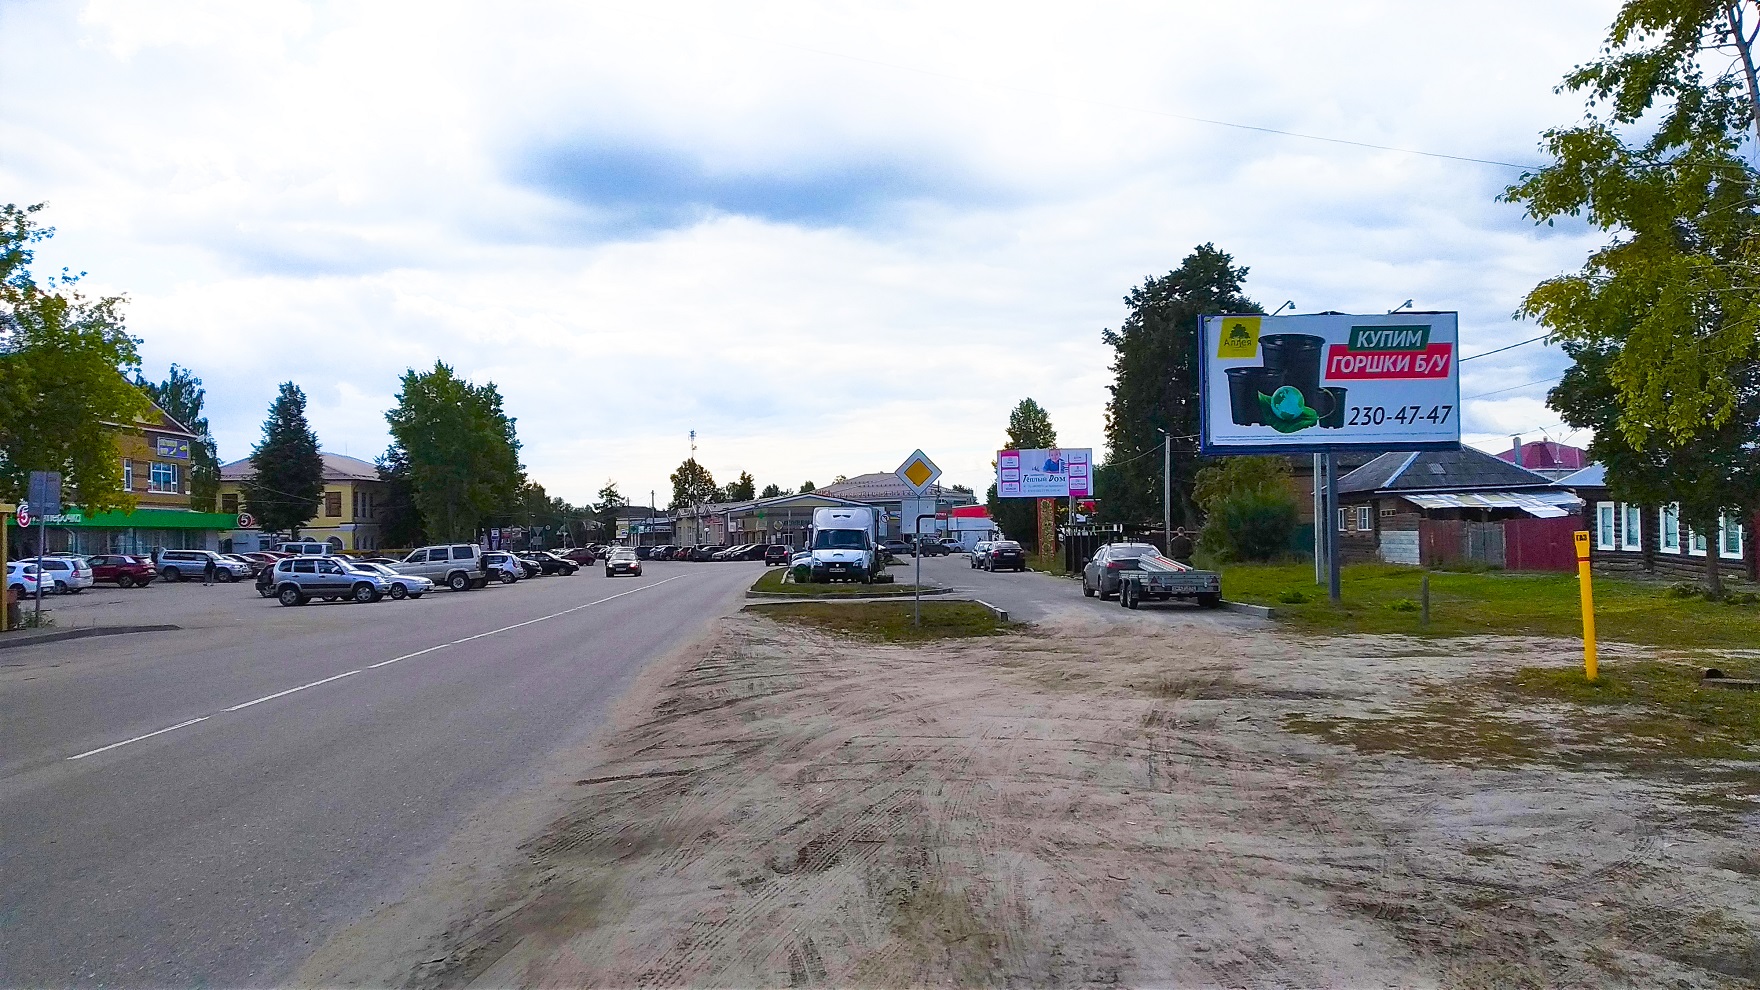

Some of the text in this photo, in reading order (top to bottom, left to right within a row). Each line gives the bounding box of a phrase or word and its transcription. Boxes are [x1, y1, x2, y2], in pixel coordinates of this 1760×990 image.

[1356, 329, 1423, 348] КУПИМ
[1330, 353, 1449, 374] ГОРШКИ Б/У
[1347, 405, 1453, 426] 230-47-47
[1049, 474, 1066, 482] Дом
